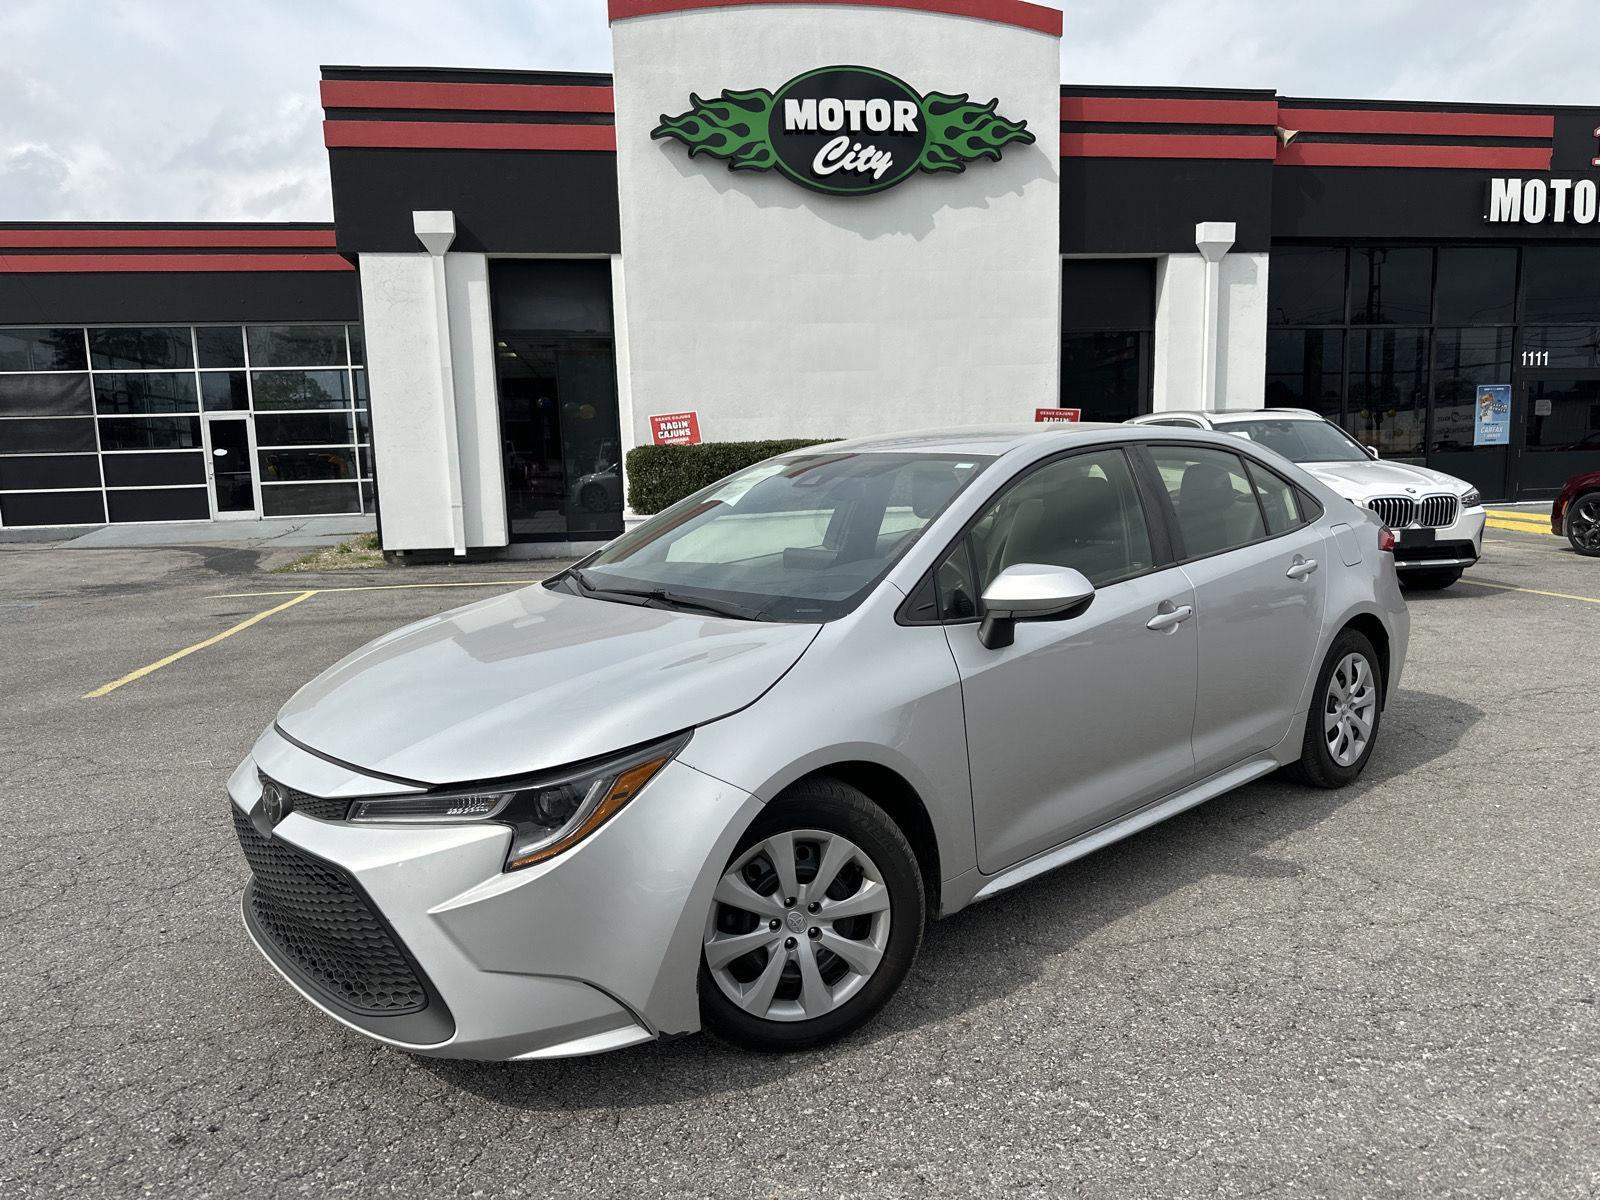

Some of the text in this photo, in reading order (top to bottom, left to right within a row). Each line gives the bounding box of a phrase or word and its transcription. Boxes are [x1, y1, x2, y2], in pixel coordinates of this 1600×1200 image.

[784, 97, 919, 132] MOTOR
[812, 135, 893, 180] City
[1489, 178, 1600, 224] MOTO
[1521, 351, 1549, 366] 1111
[657, 428, 691, 439] CAJUNS
[660, 420, 689, 431] RAGIN
